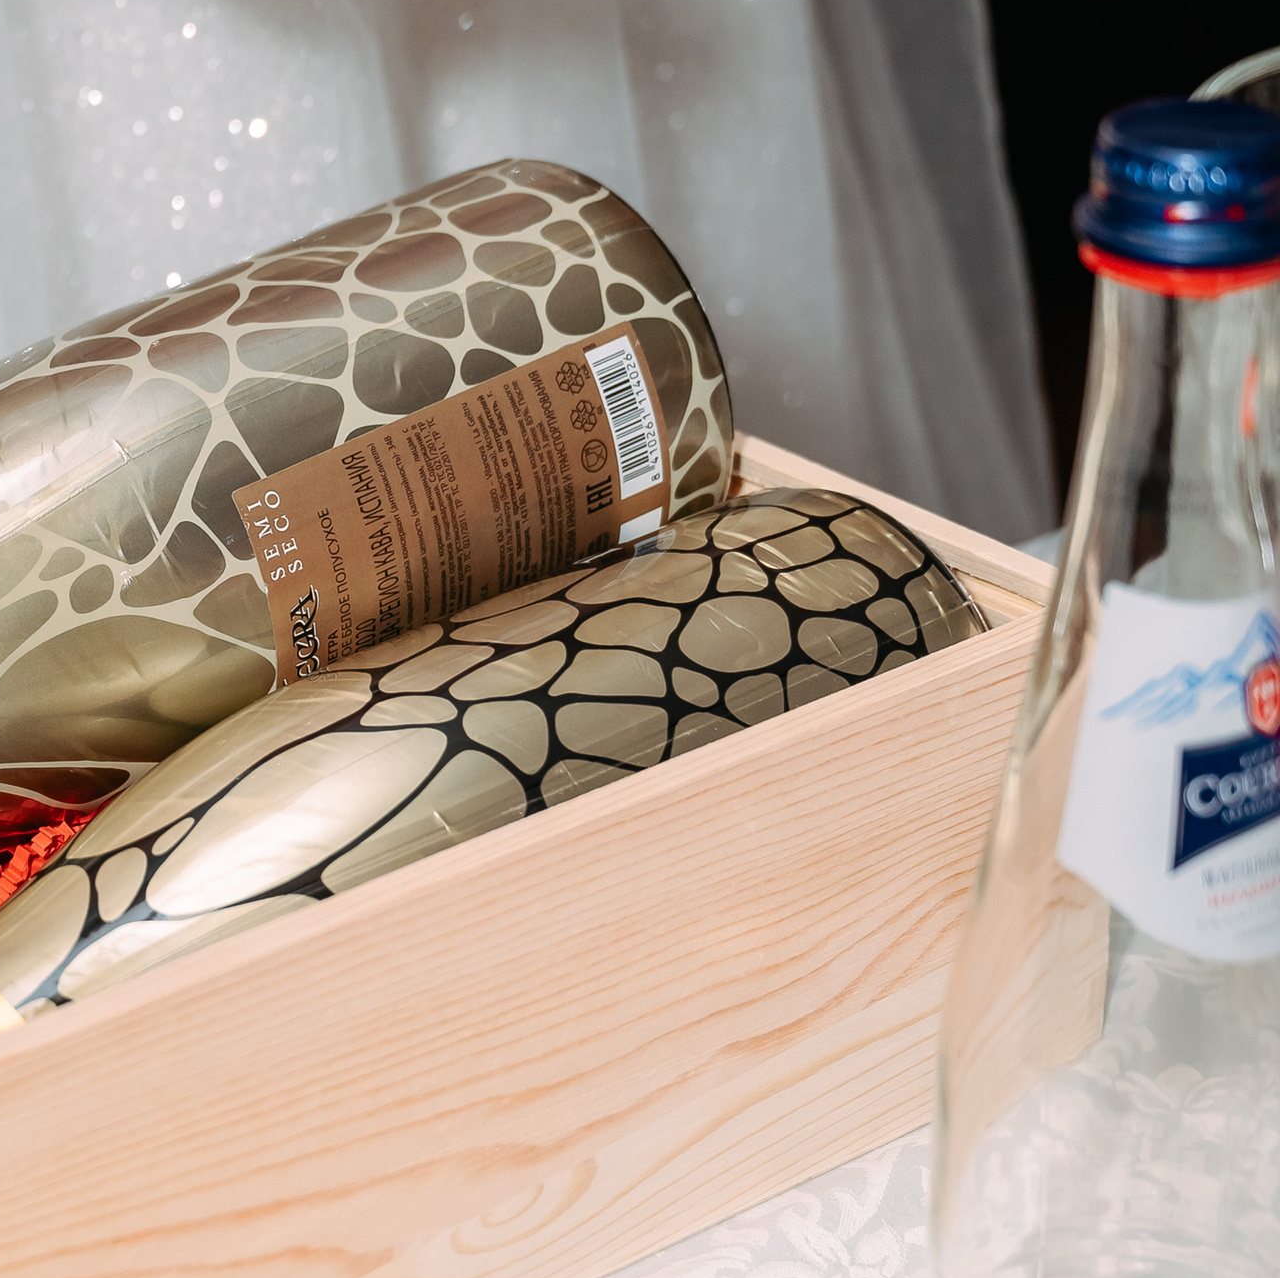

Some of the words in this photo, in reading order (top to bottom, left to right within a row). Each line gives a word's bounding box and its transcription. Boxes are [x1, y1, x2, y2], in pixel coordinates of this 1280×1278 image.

[510, 379, 526, 406] После
[623, 351, 647, 405] 114026
[417, 420, 427, 432] ТР
[425, 416, 436, 428] ТС
[431, 429, 442, 442] ТР
[460, 401, 475, 427] Geltru
[470, 427, 481, 439] La
[476, 394, 504, 452] потребителей
[527, 369, 569, 474] ТРАНСПОРТИРОВАНИЯ
[641, 411, 659, 464] 410261
[383, 434, 396, 451] 348
[340, 450, 385, 525] ИСПАНИЯ
[650, 472, 661, 482] 8
[246, 499, 286, 581] SEMI
[263, 489, 303, 574] SECO
[316, 507, 349, 593] ПОЛУСУХОЕ
[367, 521, 396, 568] КАВА,
[392, 512, 408, 559] консервант
[338, 593, 352, 637] БЕЛОЕ
[376, 565, 400, 622] РЕГИОН
[289, 584, 321, 678] EGRA
[354, 617, 376, 653] 2020
